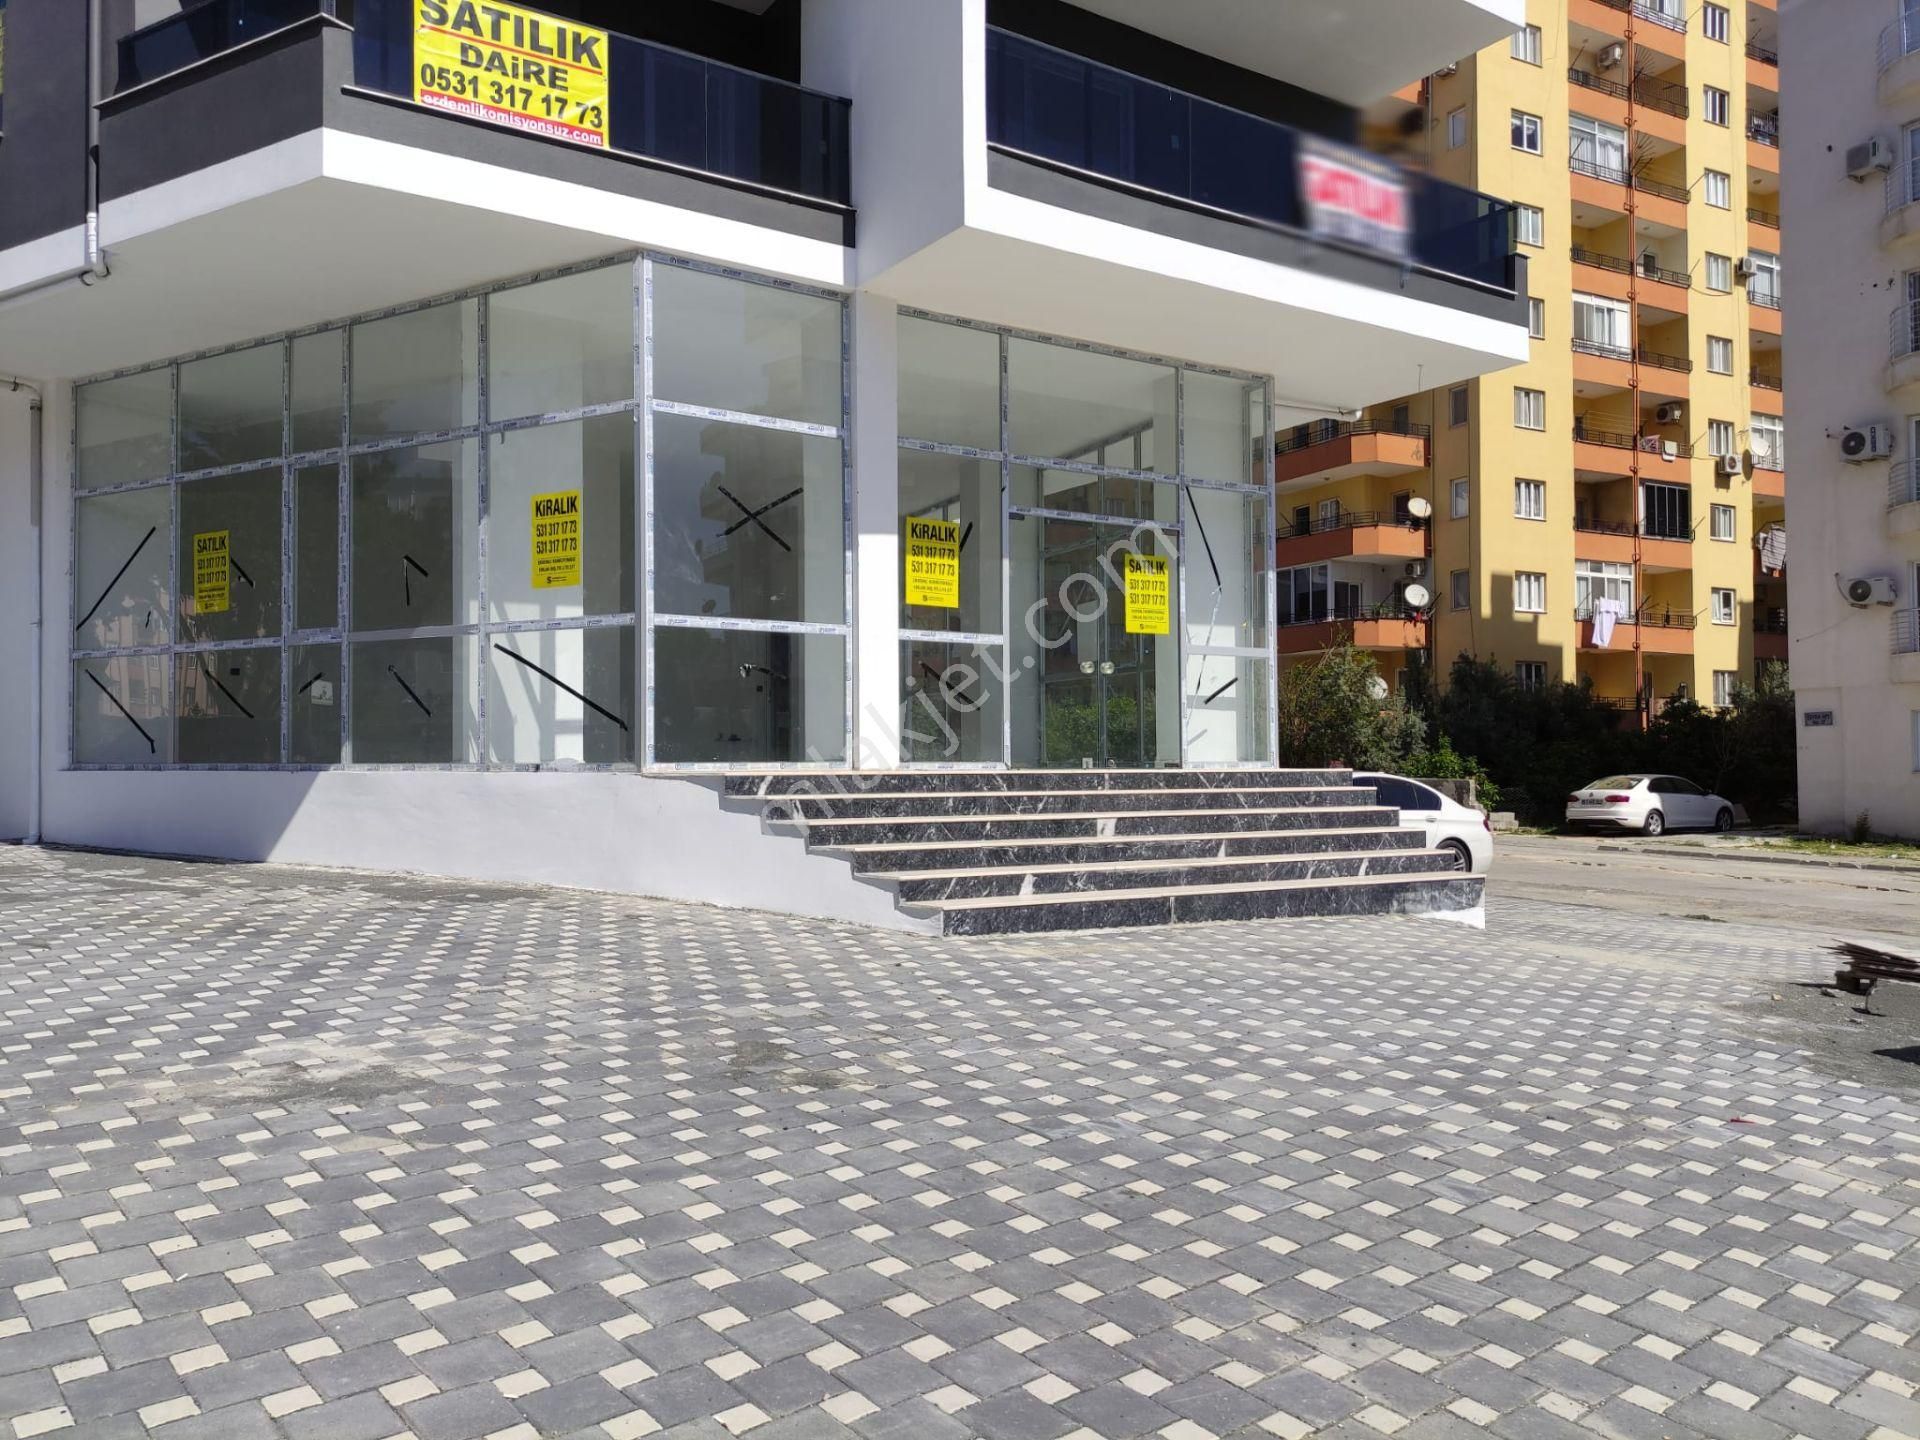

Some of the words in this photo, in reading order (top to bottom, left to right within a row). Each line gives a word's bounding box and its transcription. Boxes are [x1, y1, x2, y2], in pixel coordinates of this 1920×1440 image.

[421, 0, 602, 69] SATILIK
[421, 63, 479, 100] 0531
[490, 80, 532, 111] 317
[542, 94, 568, 119] 17
[575, 101, 603, 129] 73
[536, 523, 547, 537] 531
[548, 522, 559, 536] 317
[561, 521, 568, 535] 17
[570, 520, 577, 534] 73
[197, 536, 227, 553] SATILIK
[536, 541, 547, 554] 531
[548, 539, 559, 553] 317
[561, 538, 568, 551] 17
[570, 537, 577, 551] 73
[911, 545, 923, 557] 531
[925, 546, 937, 559] 317
[938, 548, 946, 560] 17
[948, 548, 955, 561] 73
[911, 560, 923, 573] 531
[925, 562, 936, 574] 317
[938, 563, 946, 576] 17
[947, 564, 954, 577] 73
